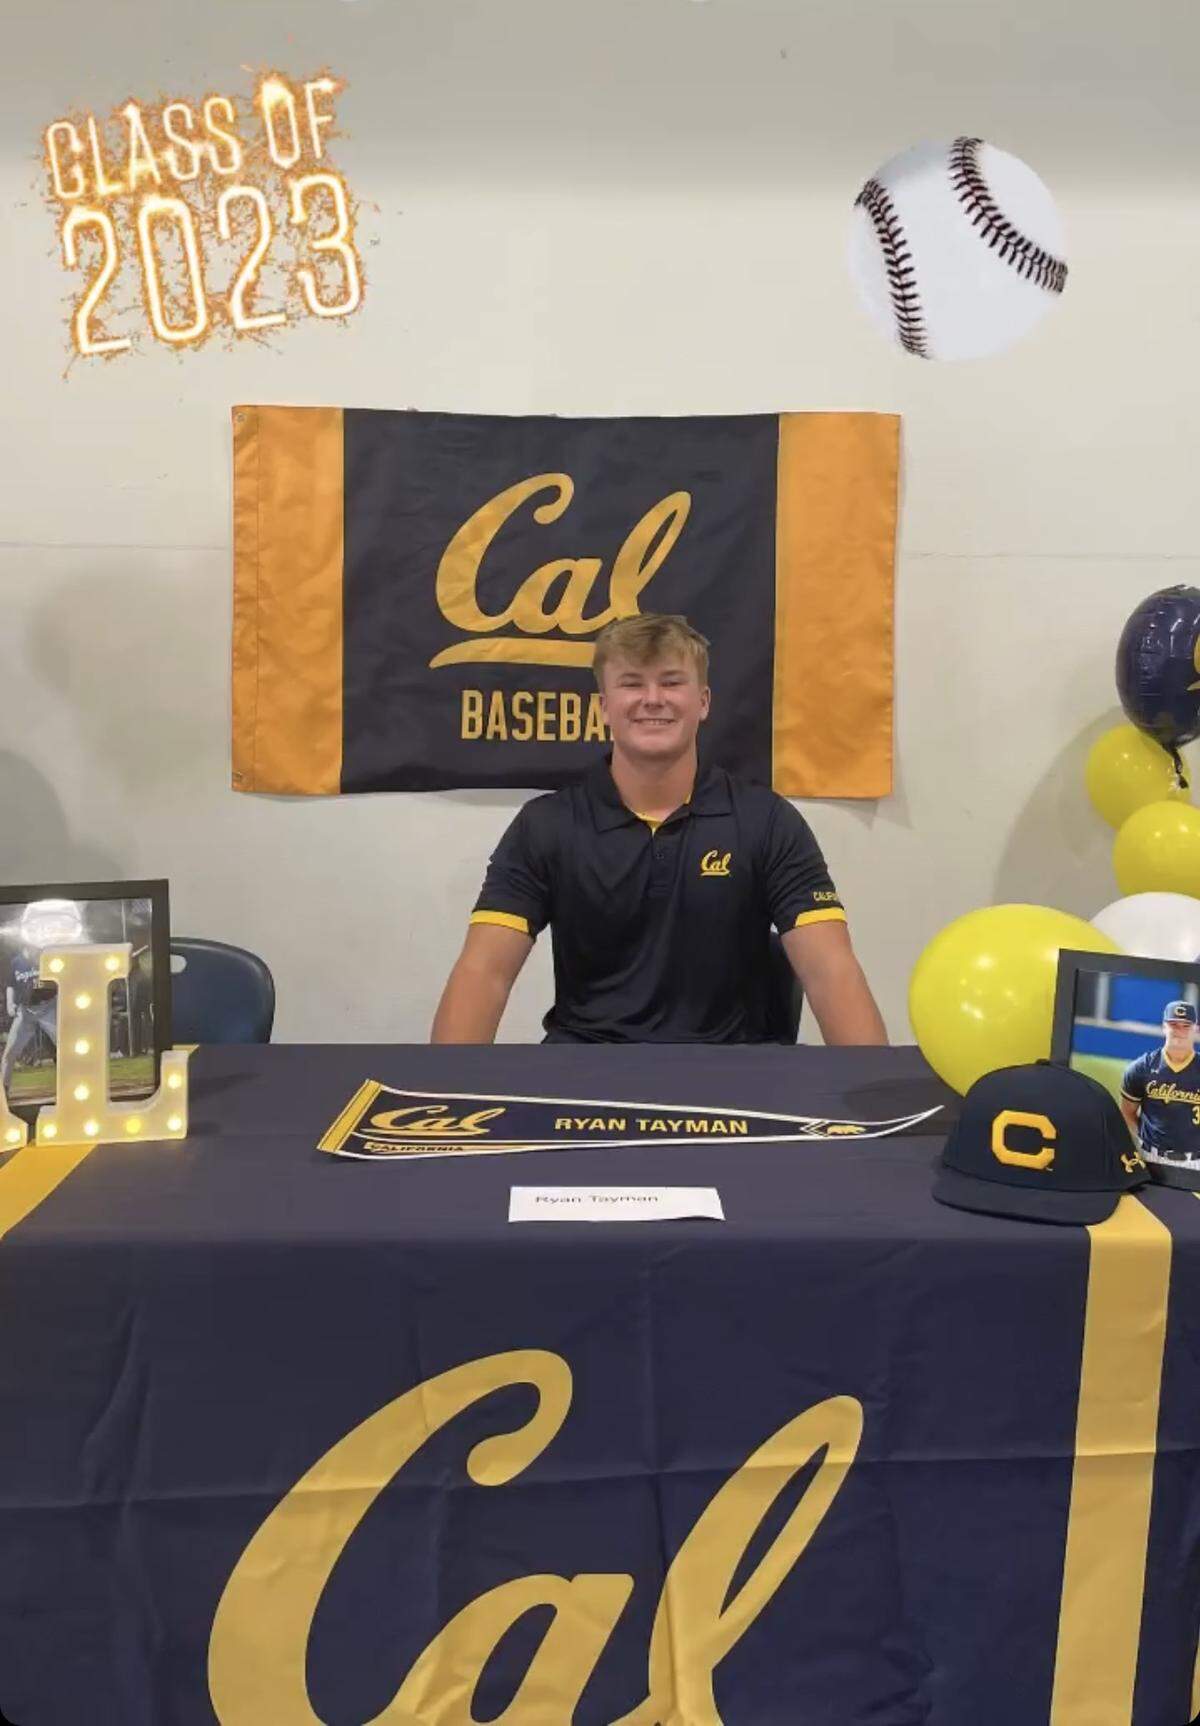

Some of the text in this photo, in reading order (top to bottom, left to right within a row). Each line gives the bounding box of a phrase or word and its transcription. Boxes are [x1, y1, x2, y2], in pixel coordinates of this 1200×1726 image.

[435, 472, 692, 636] Cal
[460, 689, 614, 743] BASEBA
[700, 849, 732, 877] Cal
[366, 1105, 748, 1136] Cal RYAN TAYMAN
[991, 1109, 1057, 1170] C
[535, 1195, 581, 1204] Ryan
[207, 1349, 864, 1726] Cal
